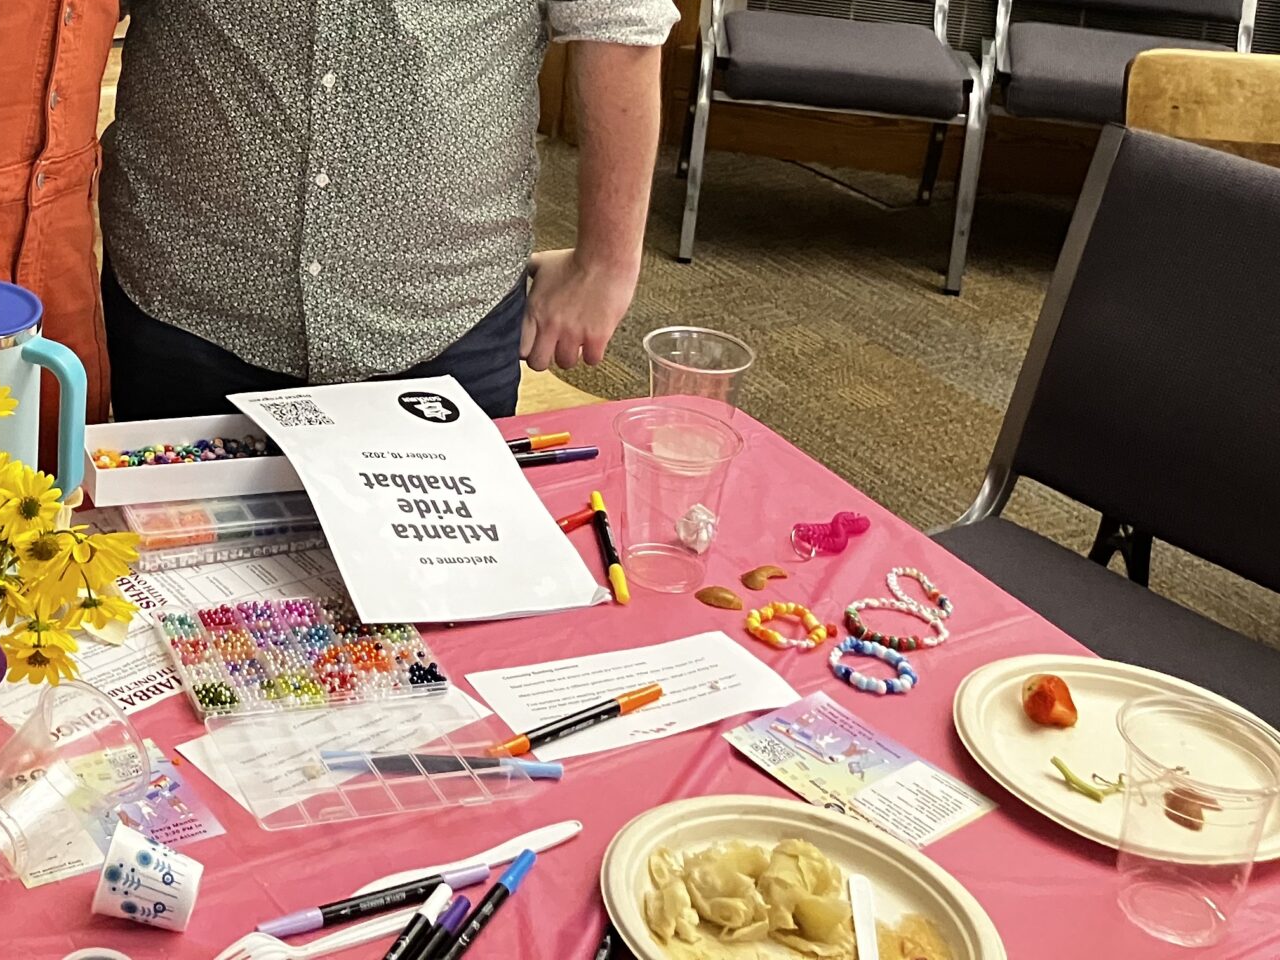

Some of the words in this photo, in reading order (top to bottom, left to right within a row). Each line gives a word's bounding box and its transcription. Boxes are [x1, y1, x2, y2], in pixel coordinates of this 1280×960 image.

[405, 452, 447, 461] October
[359, 471, 477, 495] Shabbat
[398, 497, 473, 520] Pride
[391, 522, 500, 545] Atlanta
[419, 555, 434, 566] to
[436, 554, 498, 566] Welcome
